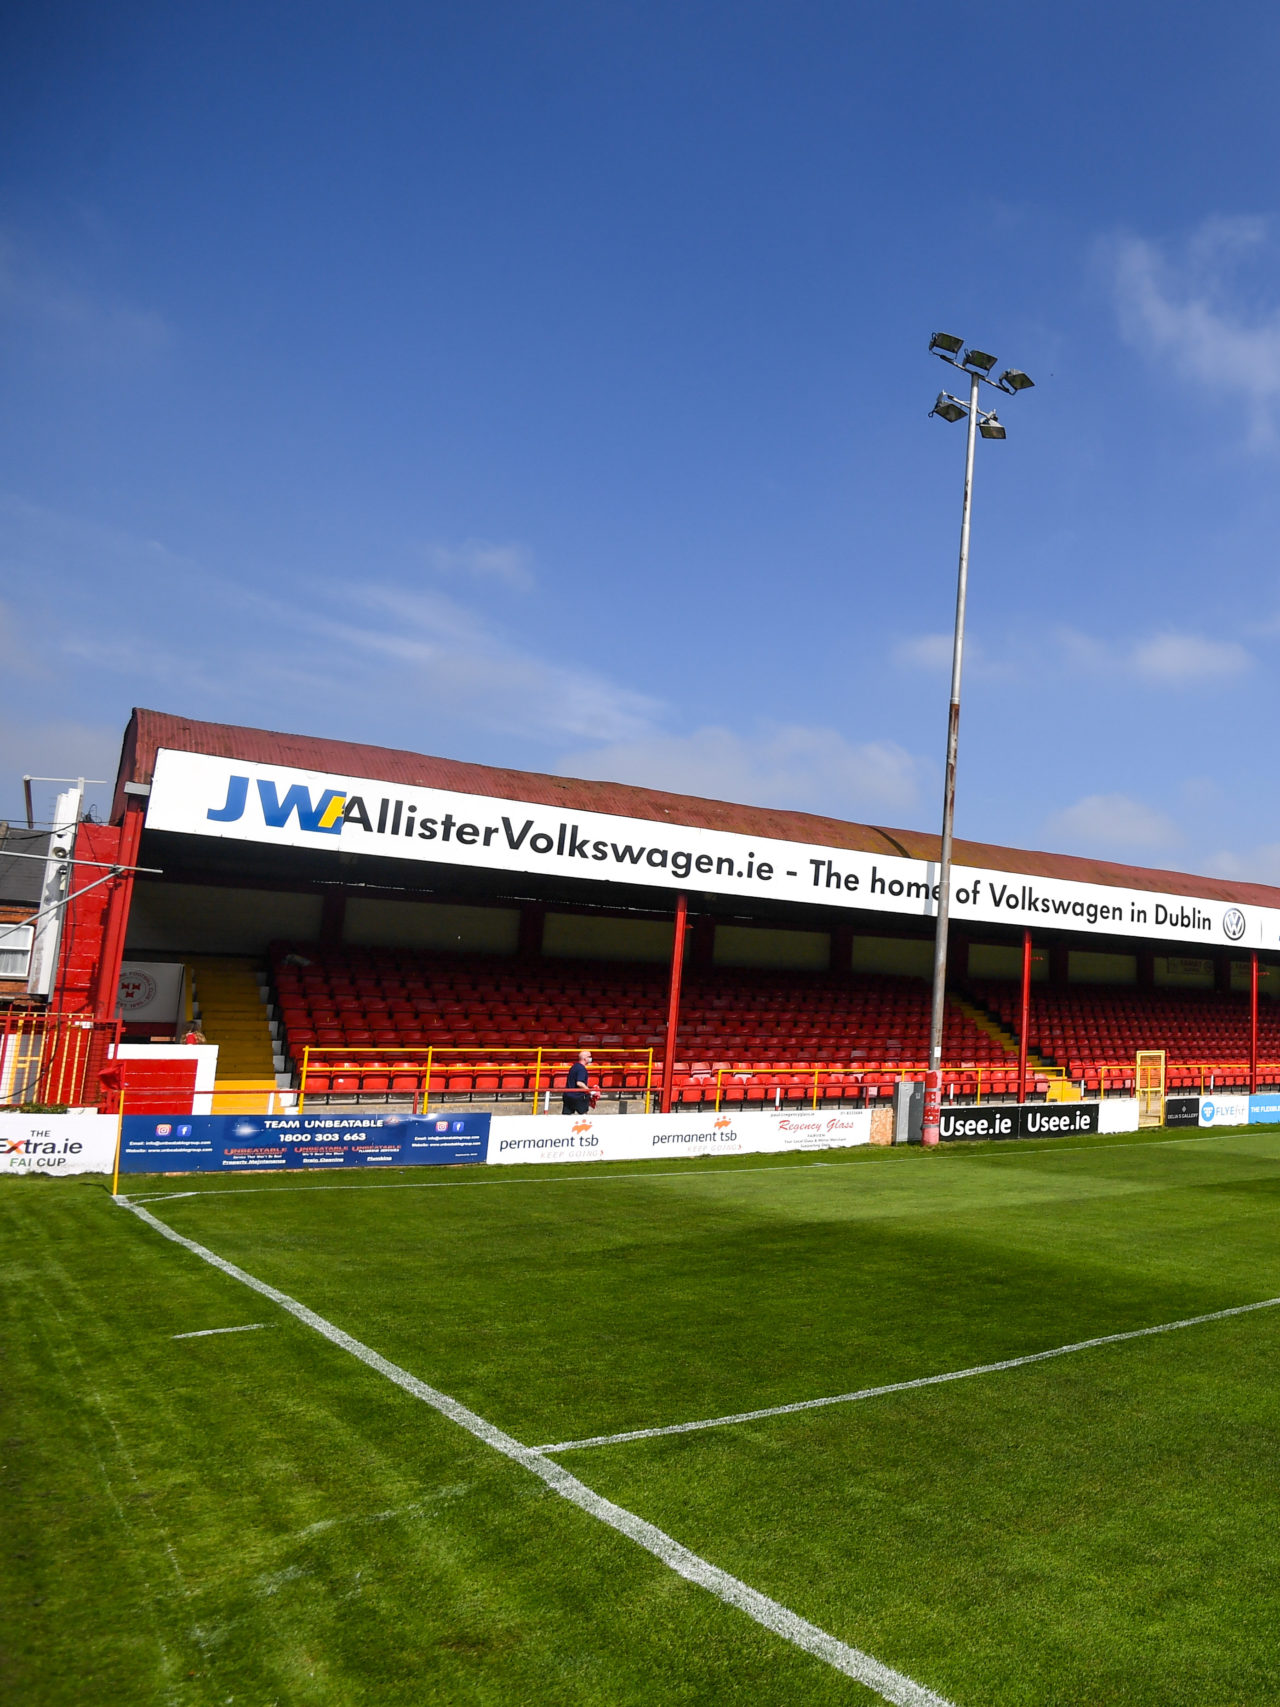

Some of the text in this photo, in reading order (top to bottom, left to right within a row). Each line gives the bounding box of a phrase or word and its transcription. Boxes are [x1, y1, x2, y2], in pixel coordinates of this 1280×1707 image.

[809, 858, 859, 891] The
[870, 866, 941, 901] home
[955, 880, 981, 905] of
[989, 883, 1123, 924] Volkswagen
[1130, 902, 1147, 923] in
[1155, 904, 1212, 930] Dublin
[264, 1119, 384, 1128] TEAM UNBEATABLE
[778, 1118, 854, 1134] Regency Glass
[940, 1111, 1090, 1136] Usee.ie Usee.ie
[279, 1132, 366, 1142] 1800 303 663
[653, 1130, 737, 1146] permanent tsb
[351, 1144, 402, 1152] UNBEATABLE
[500, 1134, 599, 1152] permanent tsb
[223, 1147, 287, 1156] UNBEATABLE
[294, 1145, 348, 1153] UNBEATABLE
[568, 1149, 598, 1157] GOING
[9, 1157, 66, 1167] FAI CUP
